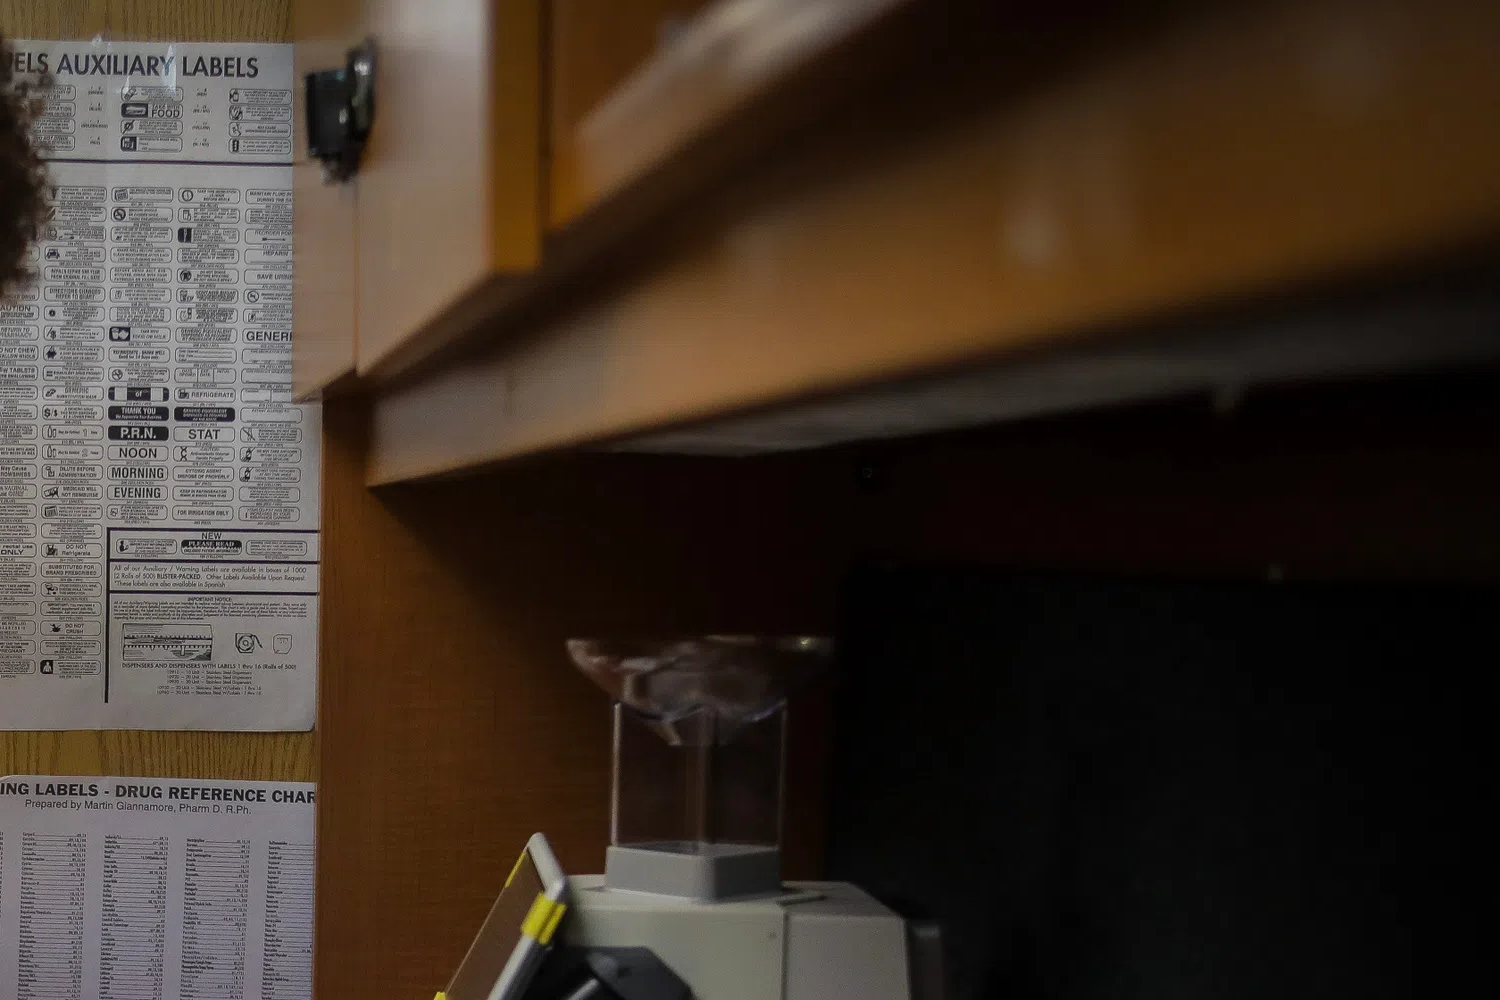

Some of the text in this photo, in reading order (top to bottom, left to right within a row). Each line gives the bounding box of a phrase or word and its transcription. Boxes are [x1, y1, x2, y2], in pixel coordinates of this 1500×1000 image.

[56, 54, 175, 77] AUXILIARY
[182, 56, 259, 79] LABELS
[151, 109, 181, 118] FOOD
[120, 428, 157, 439] P.R.N.
[188, 430, 220, 440] STAT
[120, 448, 157, 458] NOON
[112, 468, 164, 479] MORNING
[114, 488, 161, 498] EVENING
[36, 783, 98, 796] LABELS
[116, 785, 162, 798] DRUG
[168, 787, 266, 802] REFERENCE
[25, 799, 252, 815] Prepared by Martin Giannamore, Pharm D. R.Ph.
